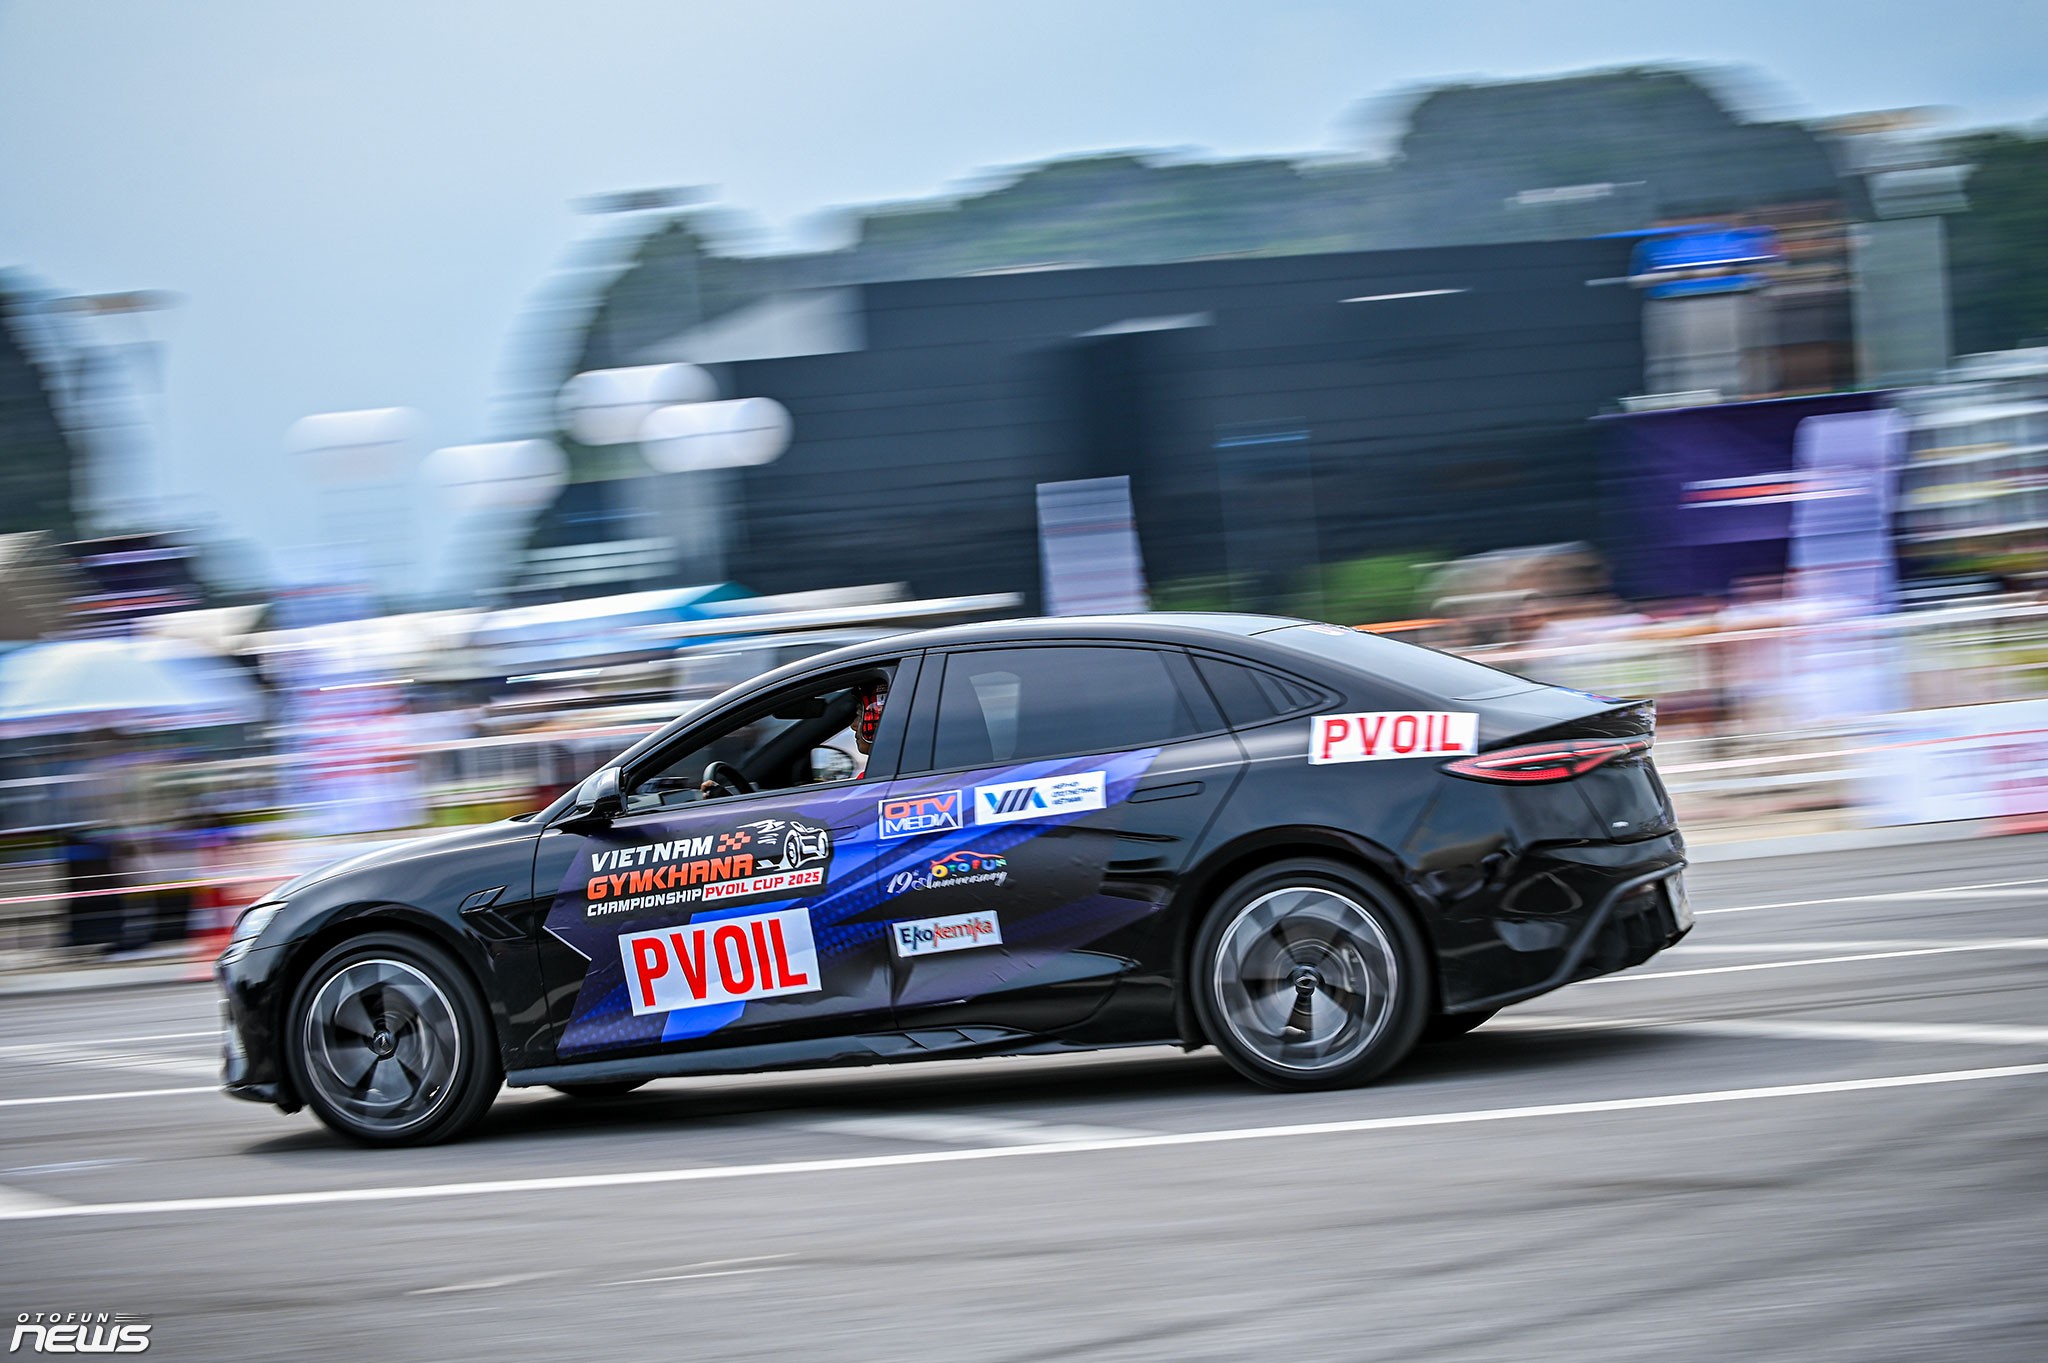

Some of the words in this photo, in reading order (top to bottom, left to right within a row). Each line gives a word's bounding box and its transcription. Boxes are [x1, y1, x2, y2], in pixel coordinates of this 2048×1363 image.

[1320, 715, 1463, 759] PVOIL
[884, 795, 956, 819] OTV
[886, 812, 959, 834] MEDIA
[591, 835, 714, 873] VIETNAM
[931, 859, 1008, 878] OTOFUN
[587, 853, 754, 900] GYMKHANA
[587, 888, 702, 917] CHAMPIONSHIP
[704, 882, 749, 899] PVOIL
[752, 876, 784, 892] CUP
[788, 871, 821, 887] 2025
[631, 918, 808, 1008] PVOIL
